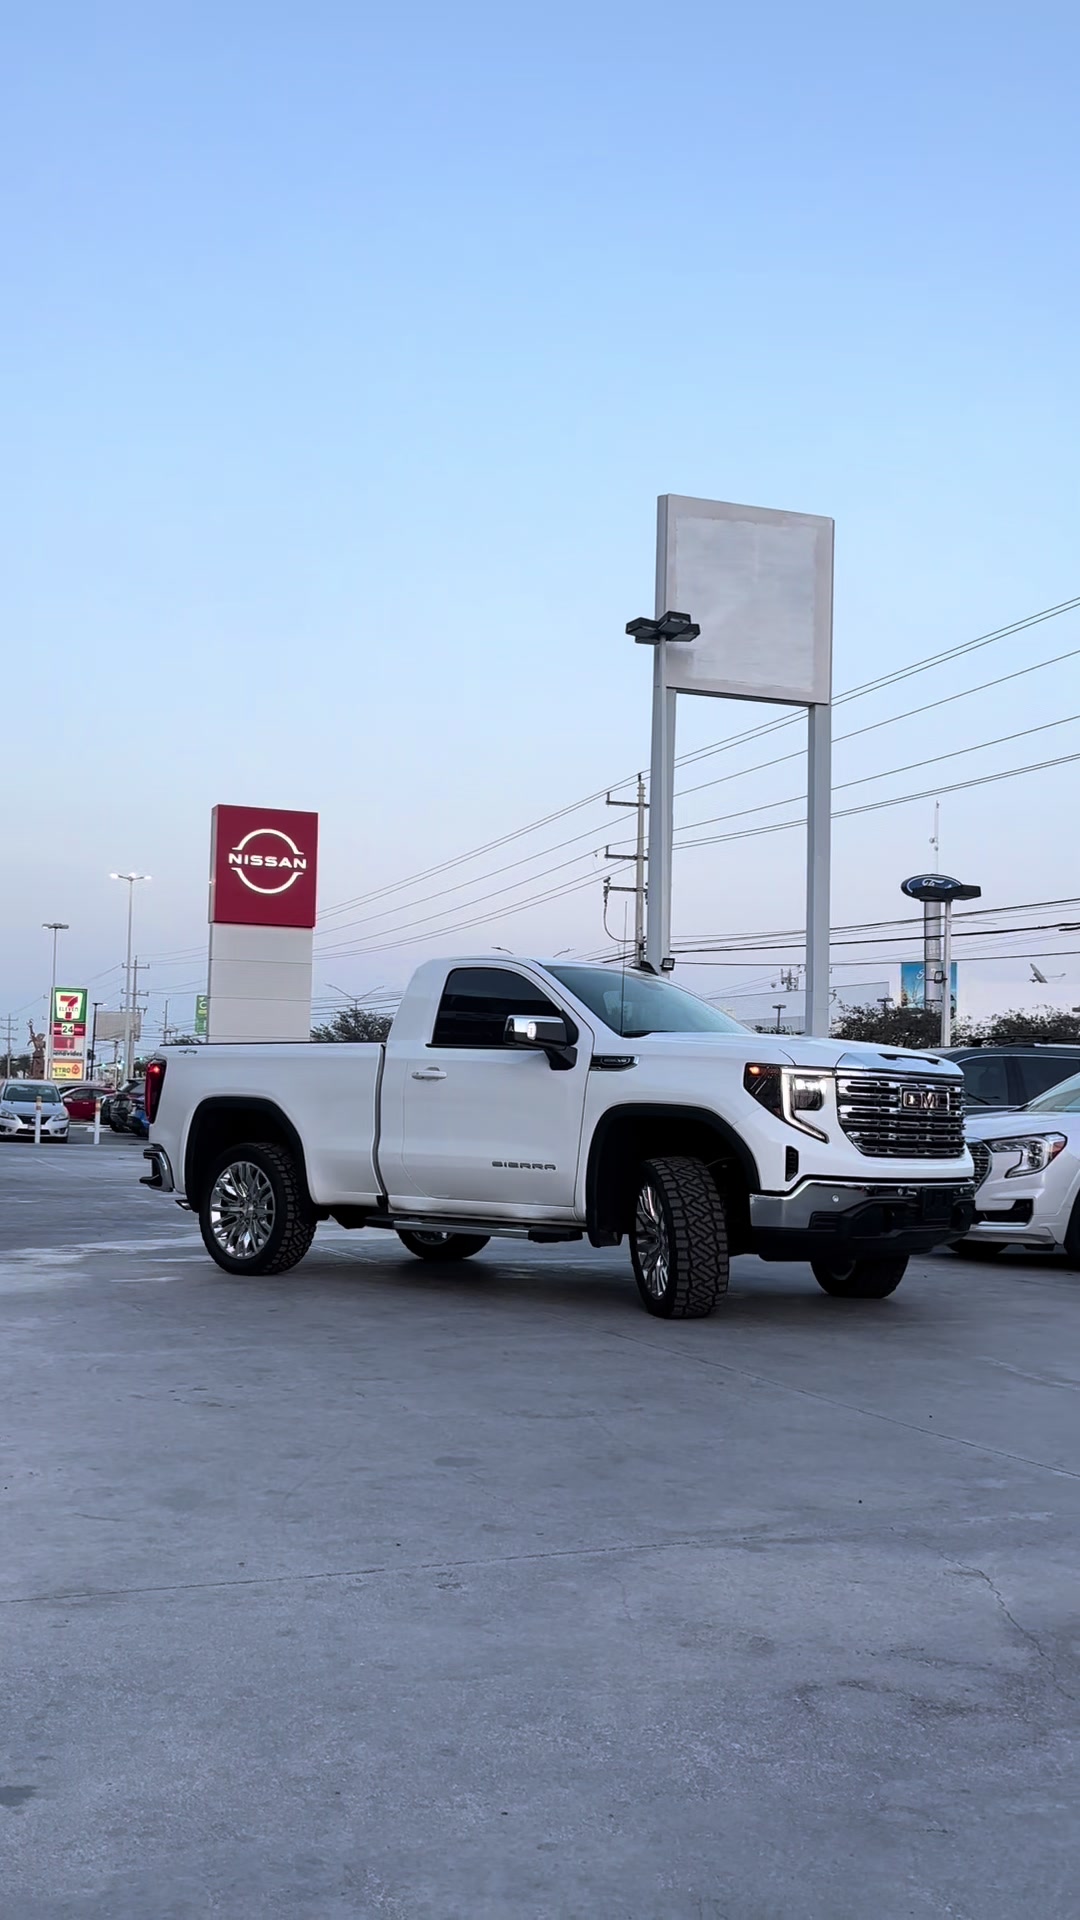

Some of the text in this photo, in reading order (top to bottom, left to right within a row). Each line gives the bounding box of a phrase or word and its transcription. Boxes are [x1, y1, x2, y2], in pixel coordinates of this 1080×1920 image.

[228, 853, 307, 869] NISSAN
[60, 995, 79, 1019] 7
[62, 1025, 74, 1033] 24
[903, 1091, 950, 1111] GMC
[491, 1161, 557, 1171] SIERRA
